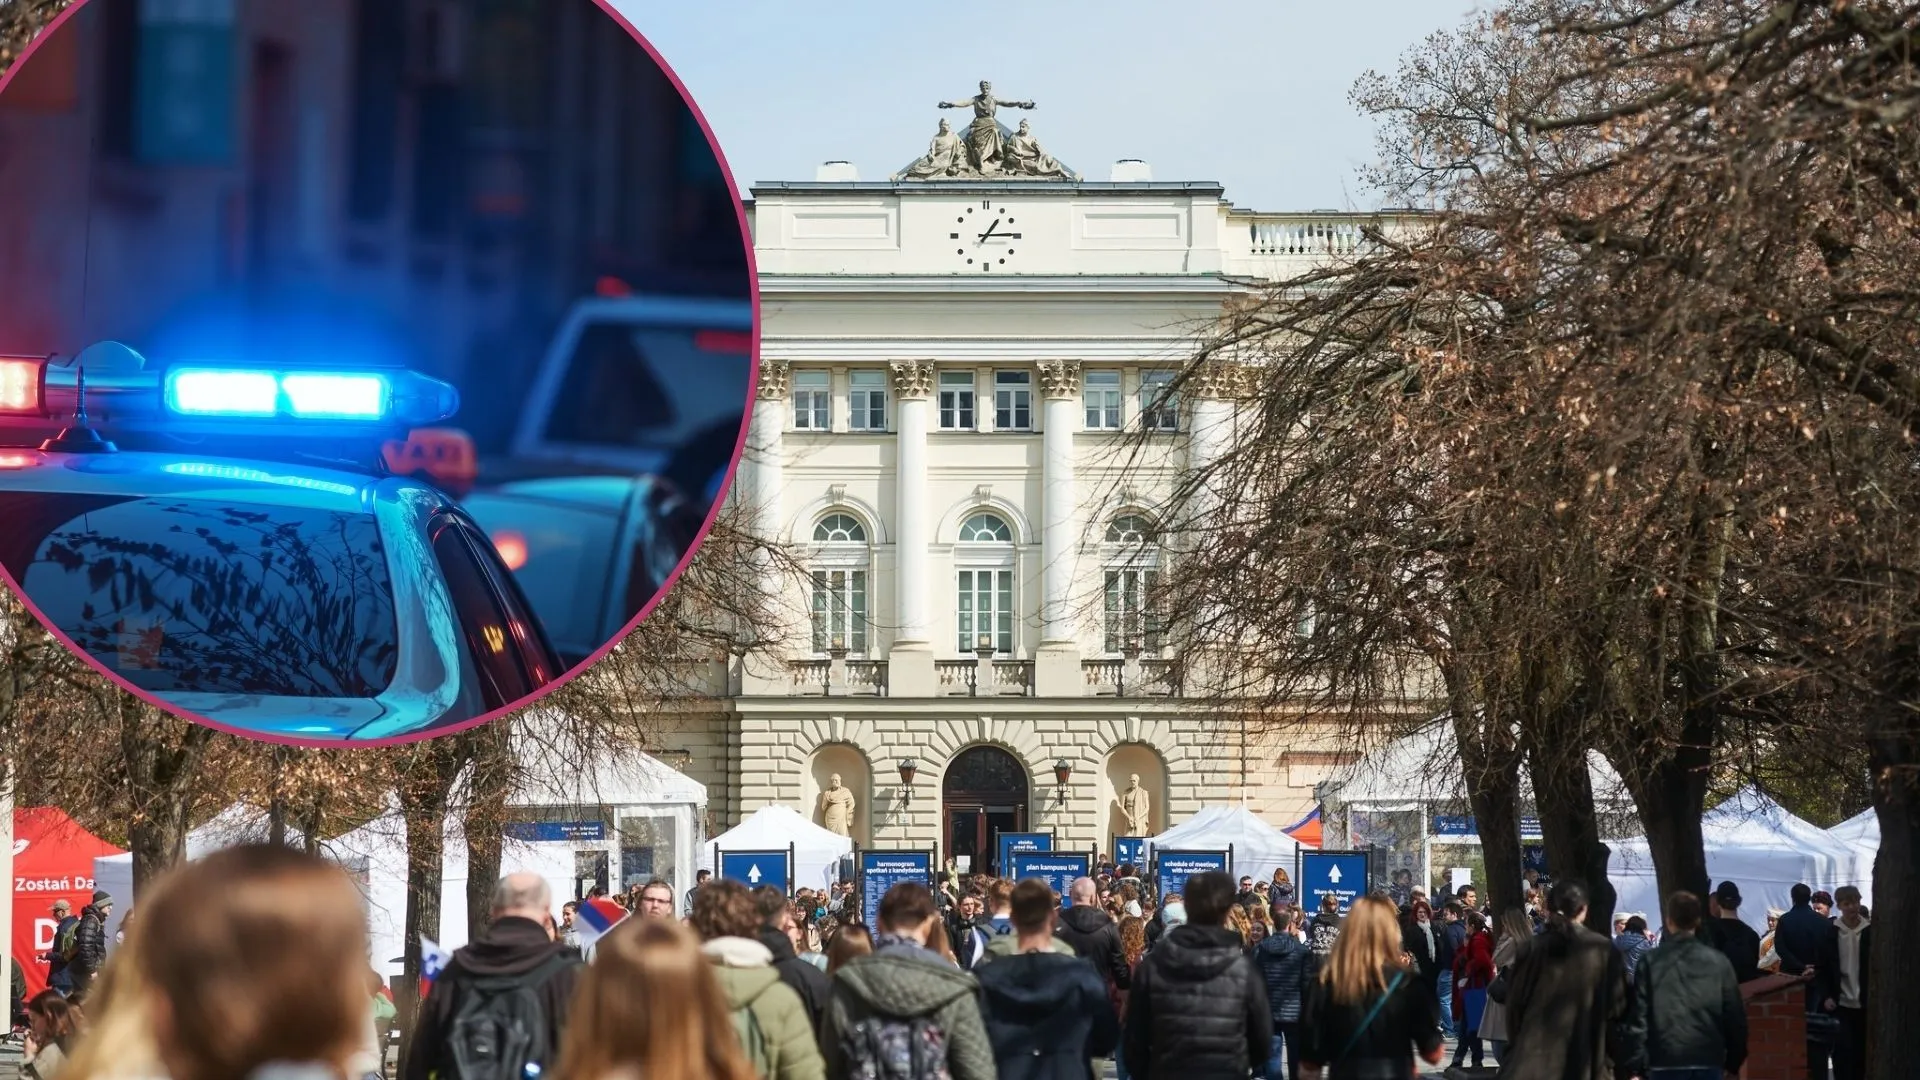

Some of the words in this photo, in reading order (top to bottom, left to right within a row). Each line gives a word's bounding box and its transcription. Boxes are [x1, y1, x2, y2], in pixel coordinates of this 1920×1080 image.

[876, 860, 915, 868] harmonogram
[1040, 863, 1067, 871] kampusu
[866, 867, 888, 875] spotkań
[892, 867, 926, 875] kandydatami
[15, 876, 70, 891] Zostań
